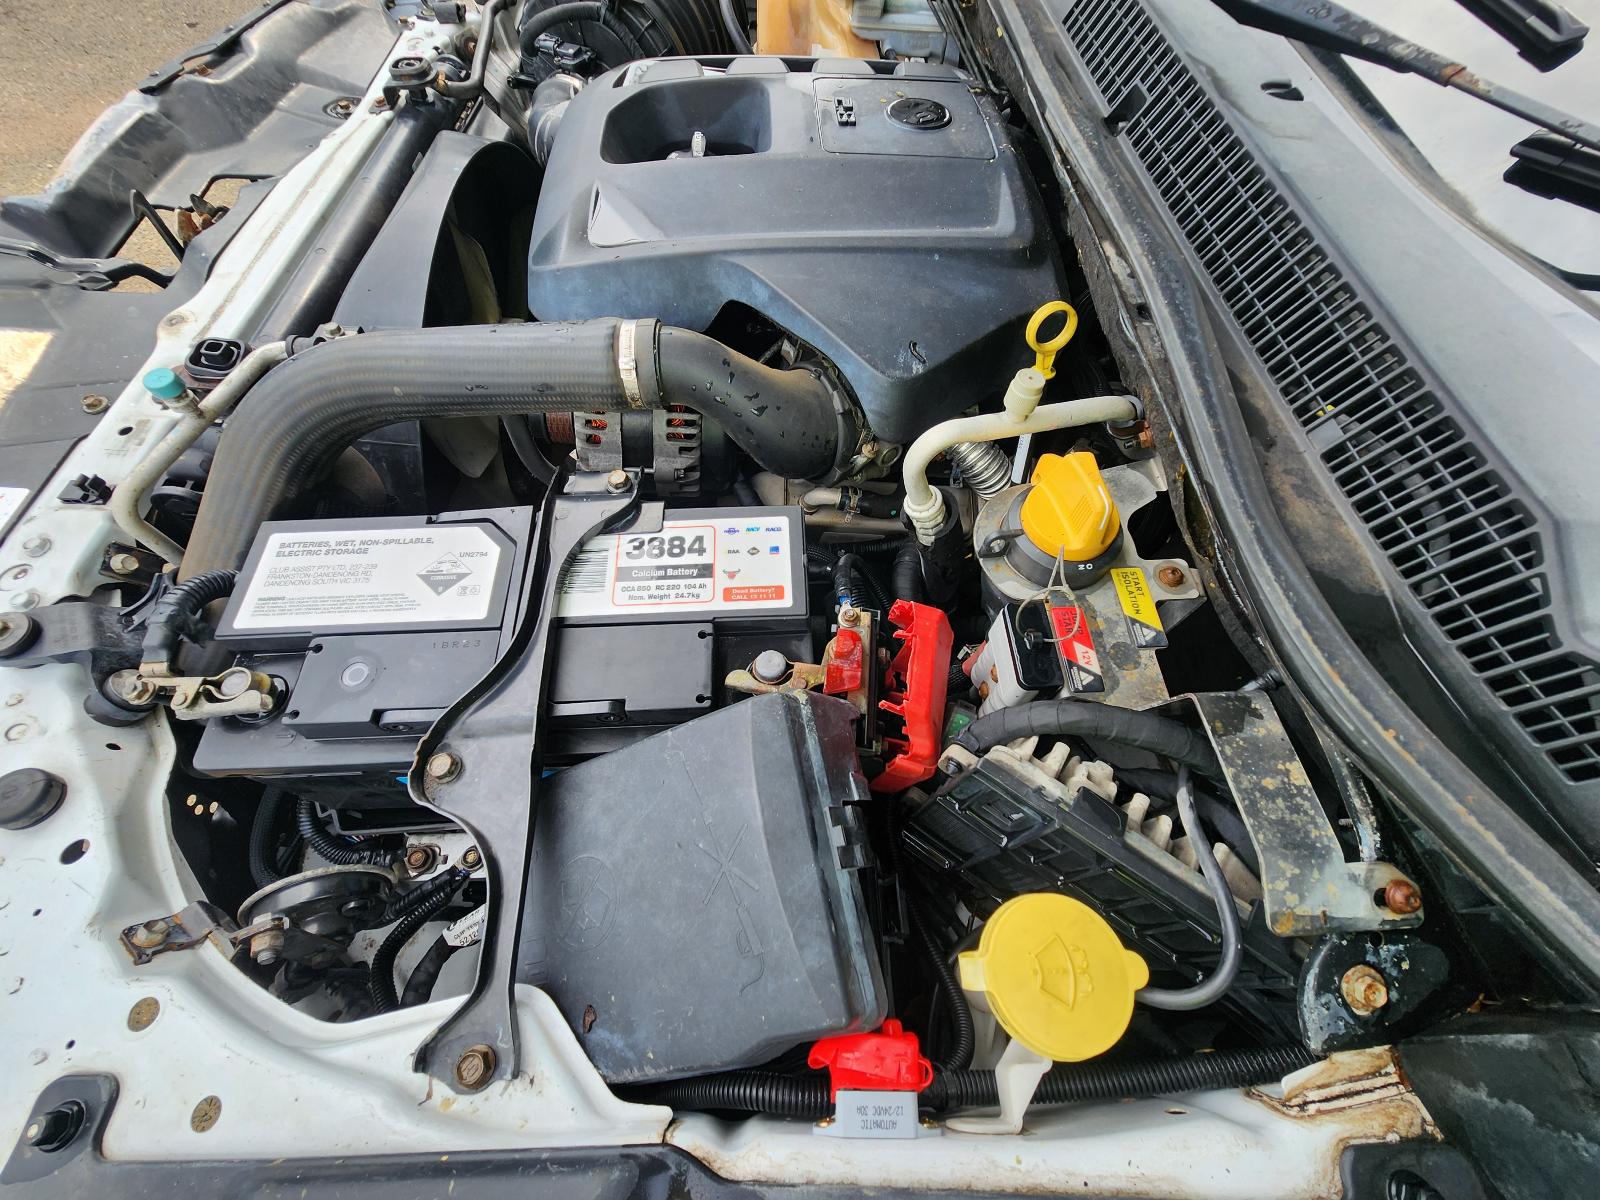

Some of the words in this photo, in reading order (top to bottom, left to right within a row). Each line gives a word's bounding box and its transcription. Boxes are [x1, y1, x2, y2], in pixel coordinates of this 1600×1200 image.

[278, 541, 332, 549] BATTERIES,
[335, 539, 357, 548] WET,
[358, 537, 434, 547] NON-SPILLABLE,
[625, 535, 707, 560] 3884
[275, 549, 323, 558] ELECTRIC
[324, 547, 369, 556] STORAGE
[291, 565, 317, 573] ASSIST
[631, 569, 665, 578] Calcium
[666, 568, 698, 577] Battery
[621, 585, 636, 593] CCA
[698, 582, 707, 590] Ah
[1129, 571, 1145, 596] START
[647, 593, 671, 601] Weight
[674, 592, 701, 600] 24.7kg
[1120, 571, 1143, 615] ISOLATION
[1080, 650, 1093, 667] 12V
[856, 1104, 869, 1117] 30A
[871, 1104, 904, 1117] 12/24VDC
[860, 1118, 898, 1130] AUTOMATIC
